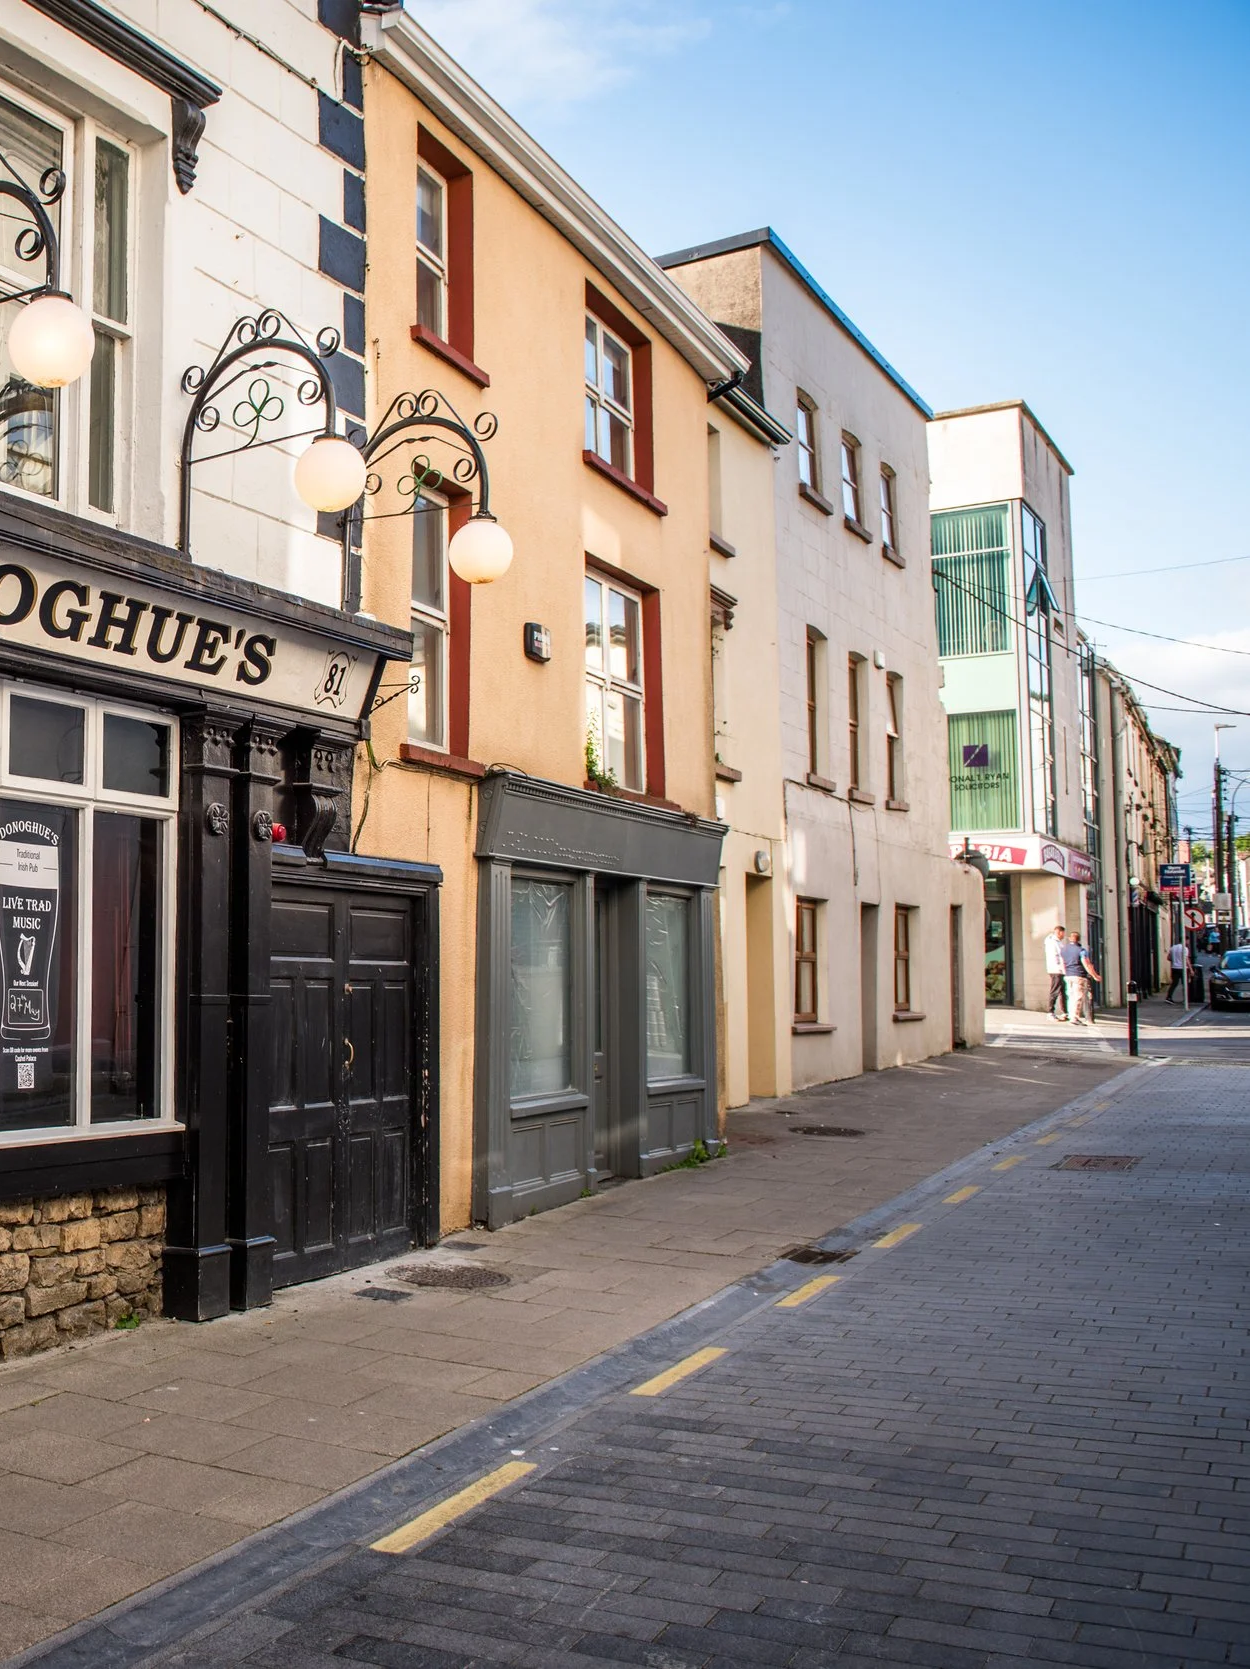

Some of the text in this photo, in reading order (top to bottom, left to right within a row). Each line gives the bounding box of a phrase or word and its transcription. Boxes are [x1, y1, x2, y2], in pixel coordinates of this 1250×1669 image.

[324, 663, 347, 696] 81
[949, 774, 974, 783] ONAL
[984, 772, 1009, 780] RYAN
[954, 782, 1000, 791] SOLICITORS
[16, 848, 40, 860] Traditional
[17, 861, 39, 873] Irish Pub
[2, 896, 52, 912] LIVE TRAD
[12, 916, 41, 930] MUSIC
[23, 1000, 40, 1021] May
[25, 1054, 37, 1062] Palace
